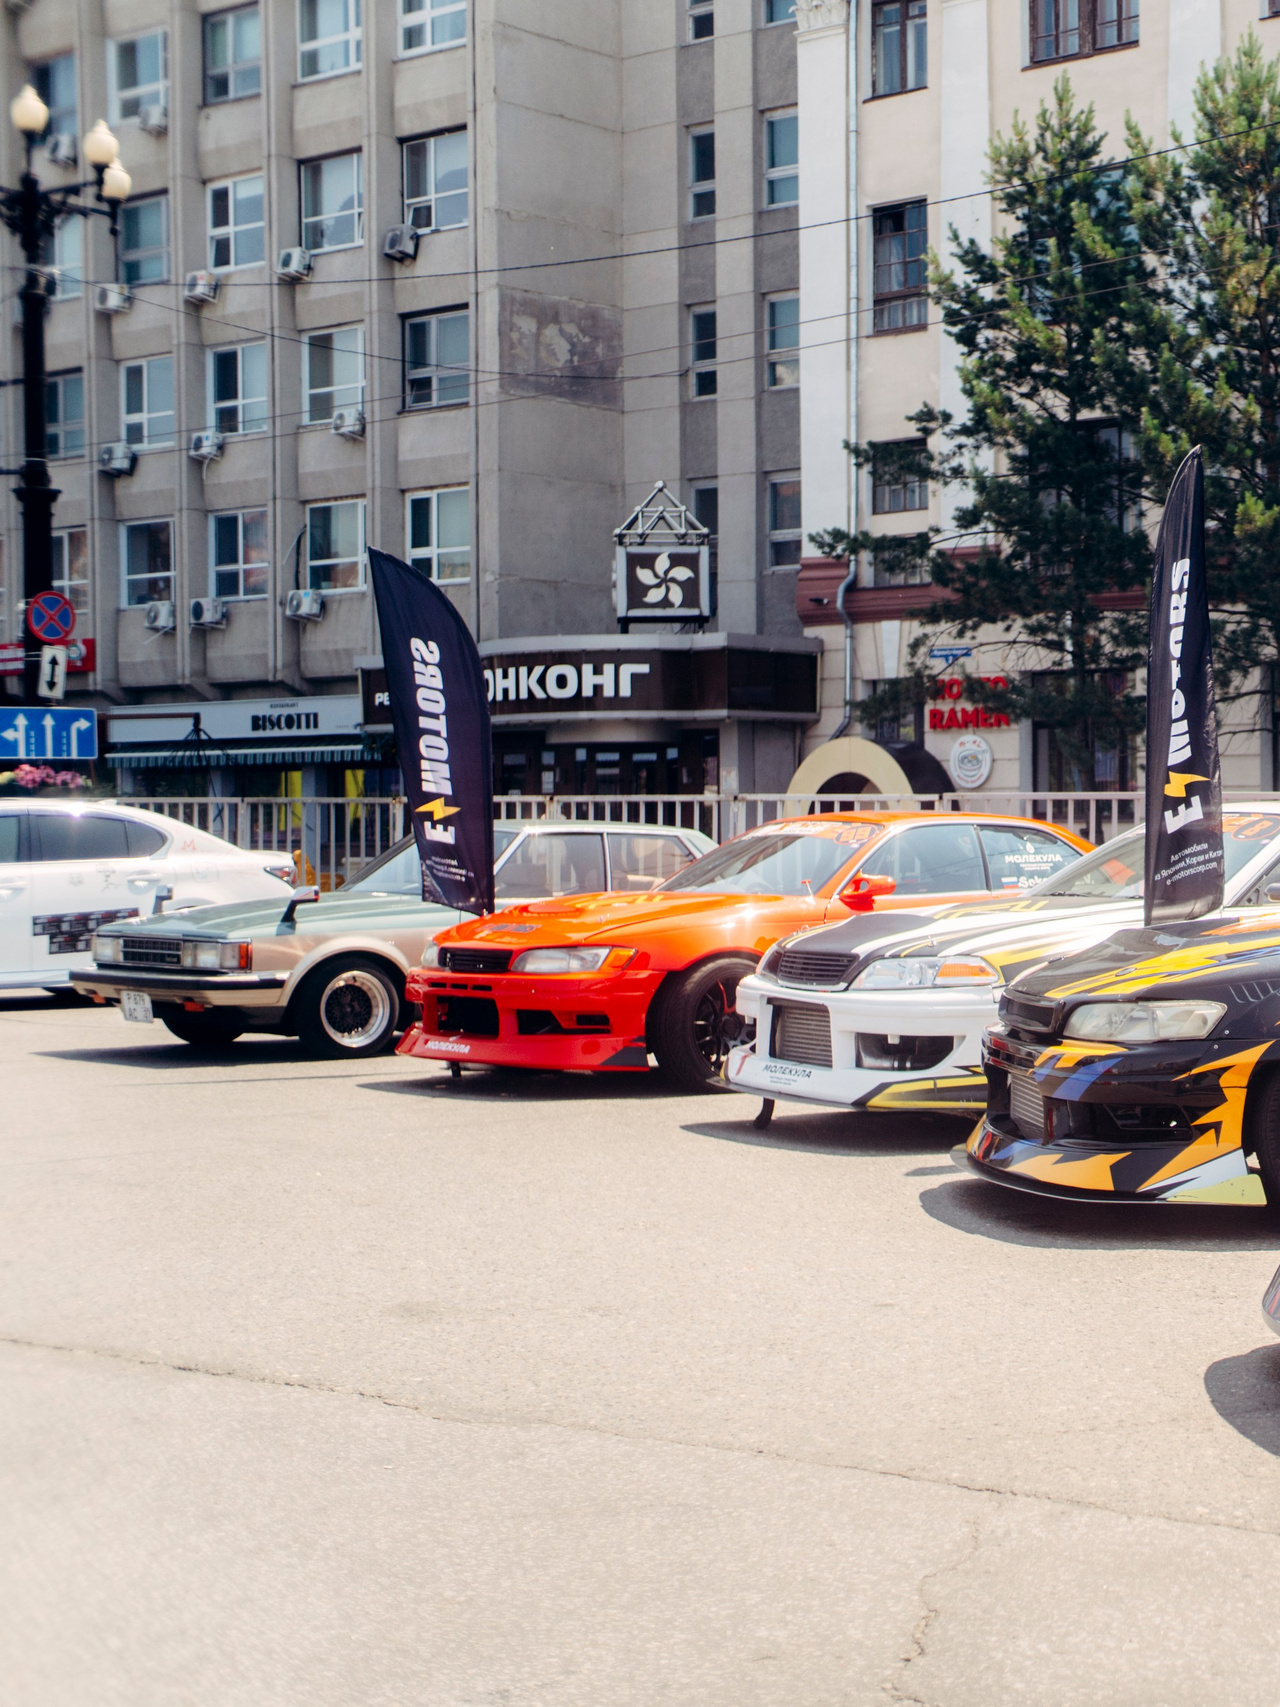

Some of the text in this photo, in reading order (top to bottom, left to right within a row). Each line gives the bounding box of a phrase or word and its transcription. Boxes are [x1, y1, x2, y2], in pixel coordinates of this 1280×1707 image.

[483, 663, 650, 702] ОНКОНГ
[251, 712, 319, 731] BISCOTTI
[929, 707, 1010, 730] RAMEN
[1004, 853, 1063, 863] МОЛЕКУЛА
[424, 1040, 471, 1054] МОЛЕКУЛА
[762, 1064, 812, 1079] МОЛЕКУЛА
